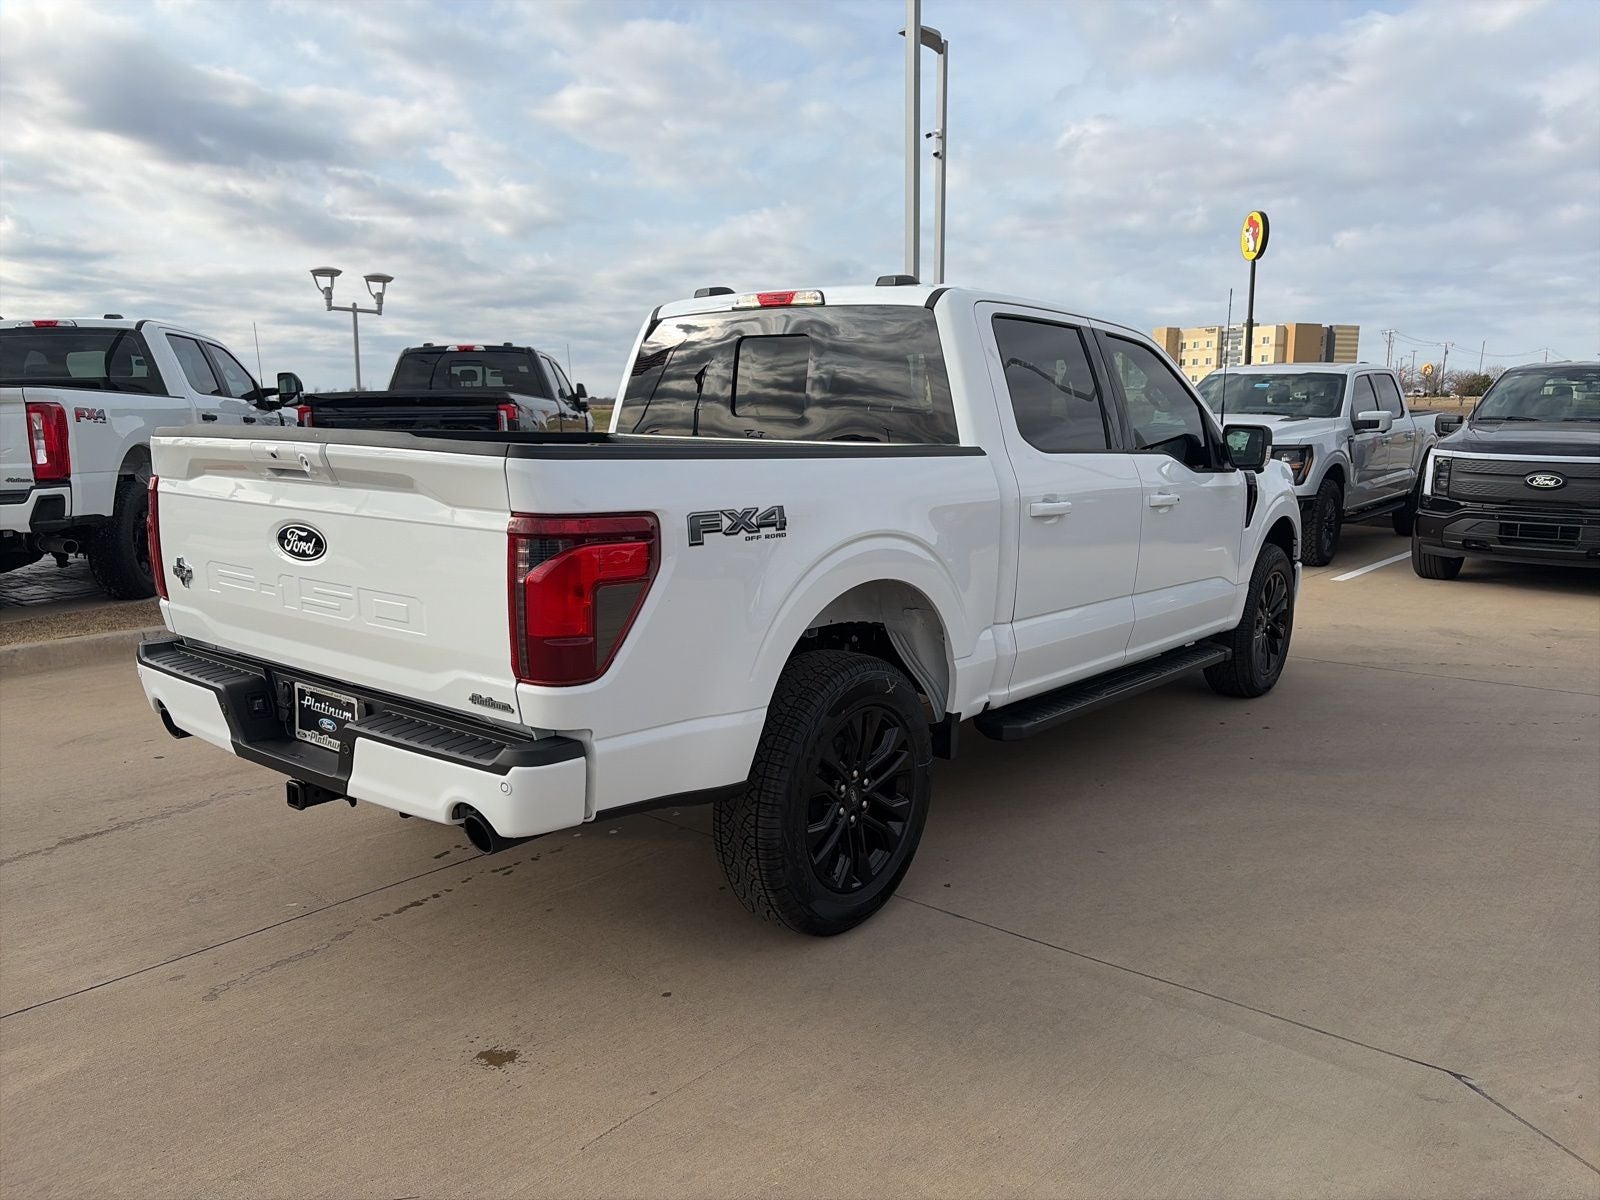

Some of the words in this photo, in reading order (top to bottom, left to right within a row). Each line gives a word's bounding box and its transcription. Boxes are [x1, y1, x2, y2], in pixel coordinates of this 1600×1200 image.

[74, 407, 106, 422] FX4
[687, 505, 787, 547] FX4
[764, 532, 787, 540] ROAD
[284, 528, 317, 555] Ford
[206, 560, 427, 636] F-150
[300, 696, 355, 722] Platinum
